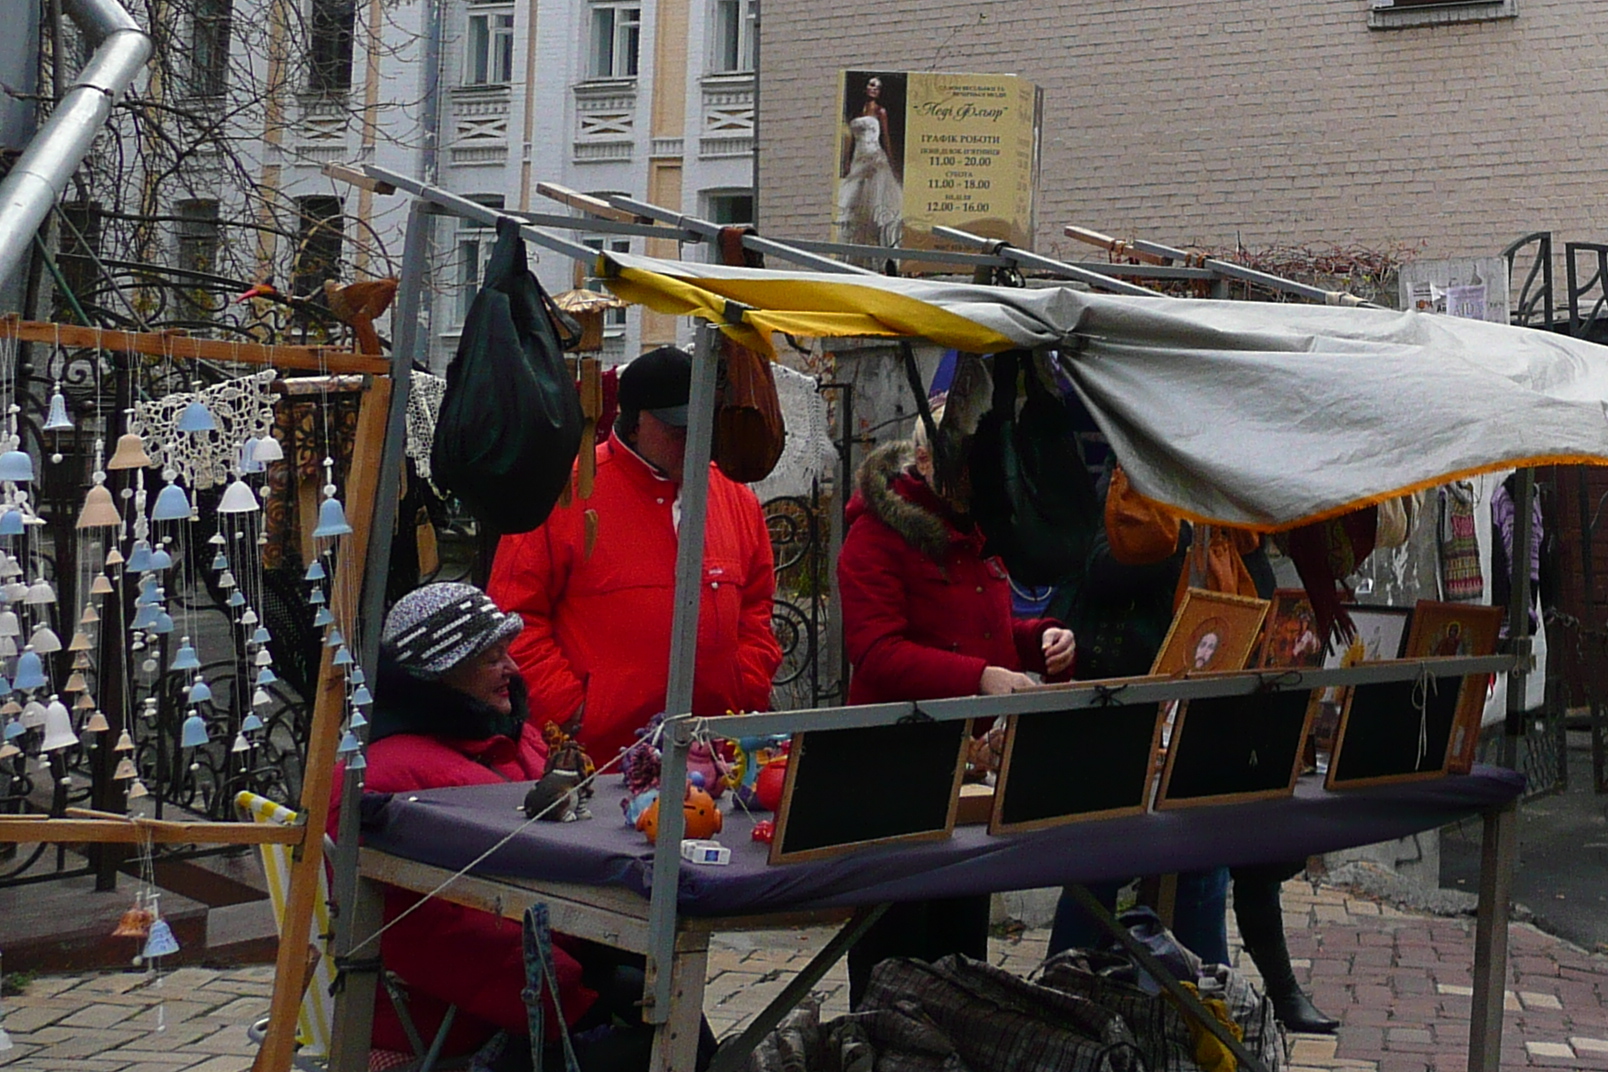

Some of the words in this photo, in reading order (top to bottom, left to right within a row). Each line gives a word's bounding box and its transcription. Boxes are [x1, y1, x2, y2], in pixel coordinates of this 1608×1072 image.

[921, 134, 958, 143] ГРАФІК
[960, 135, 1000, 144] РОБОТИ
[929, 156, 956, 166] 11.00
[964, 156, 991, 167] 20.00
[928, 179, 954, 189] 11.00
[964, 179, 991, 190] 18.00
[927, 201, 953, 212] 12.00
[963, 202, 989, 213] 16.00
